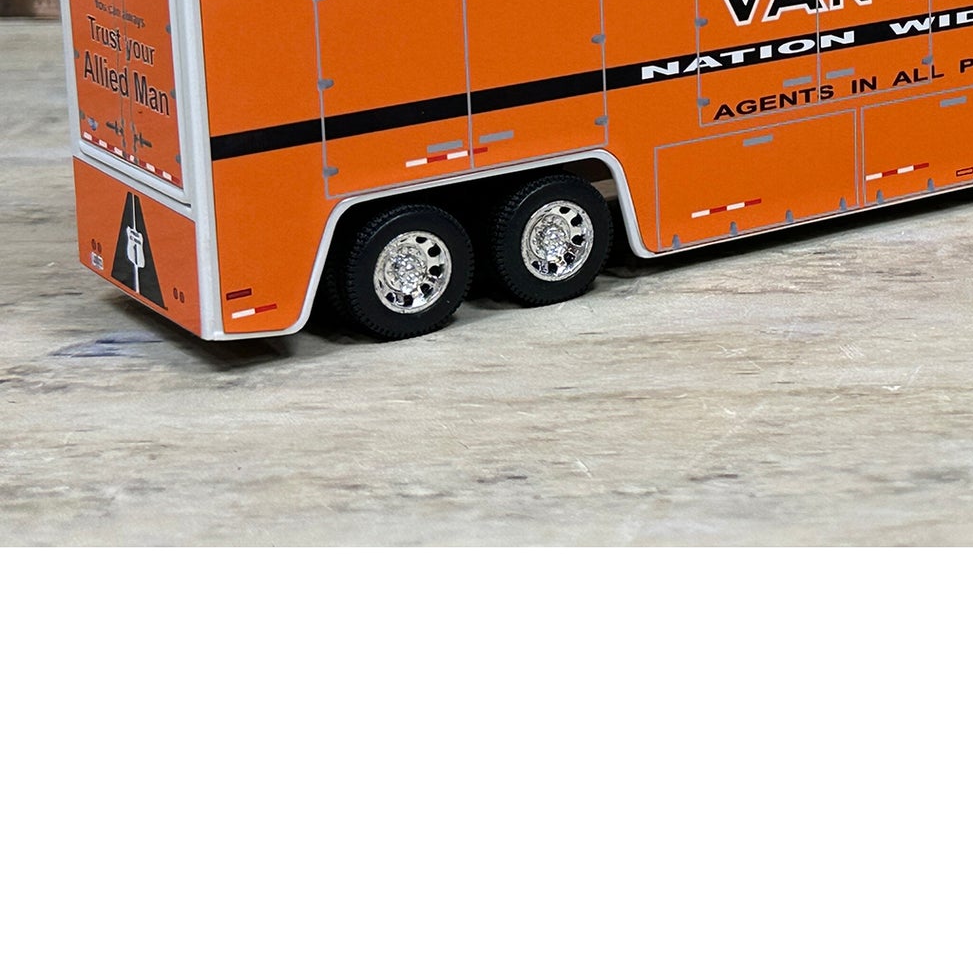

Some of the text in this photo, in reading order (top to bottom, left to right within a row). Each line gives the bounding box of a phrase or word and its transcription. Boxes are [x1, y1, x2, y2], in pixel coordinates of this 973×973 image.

[87, 14, 155, 66] Trust your
[641, 30, 855, 80] NATION
[83, 50, 171, 117] Allied Man
[713, 84, 834, 121] AGENTS
[851, 76, 877, 94] IN
[892, 64, 945, 87] ALL
